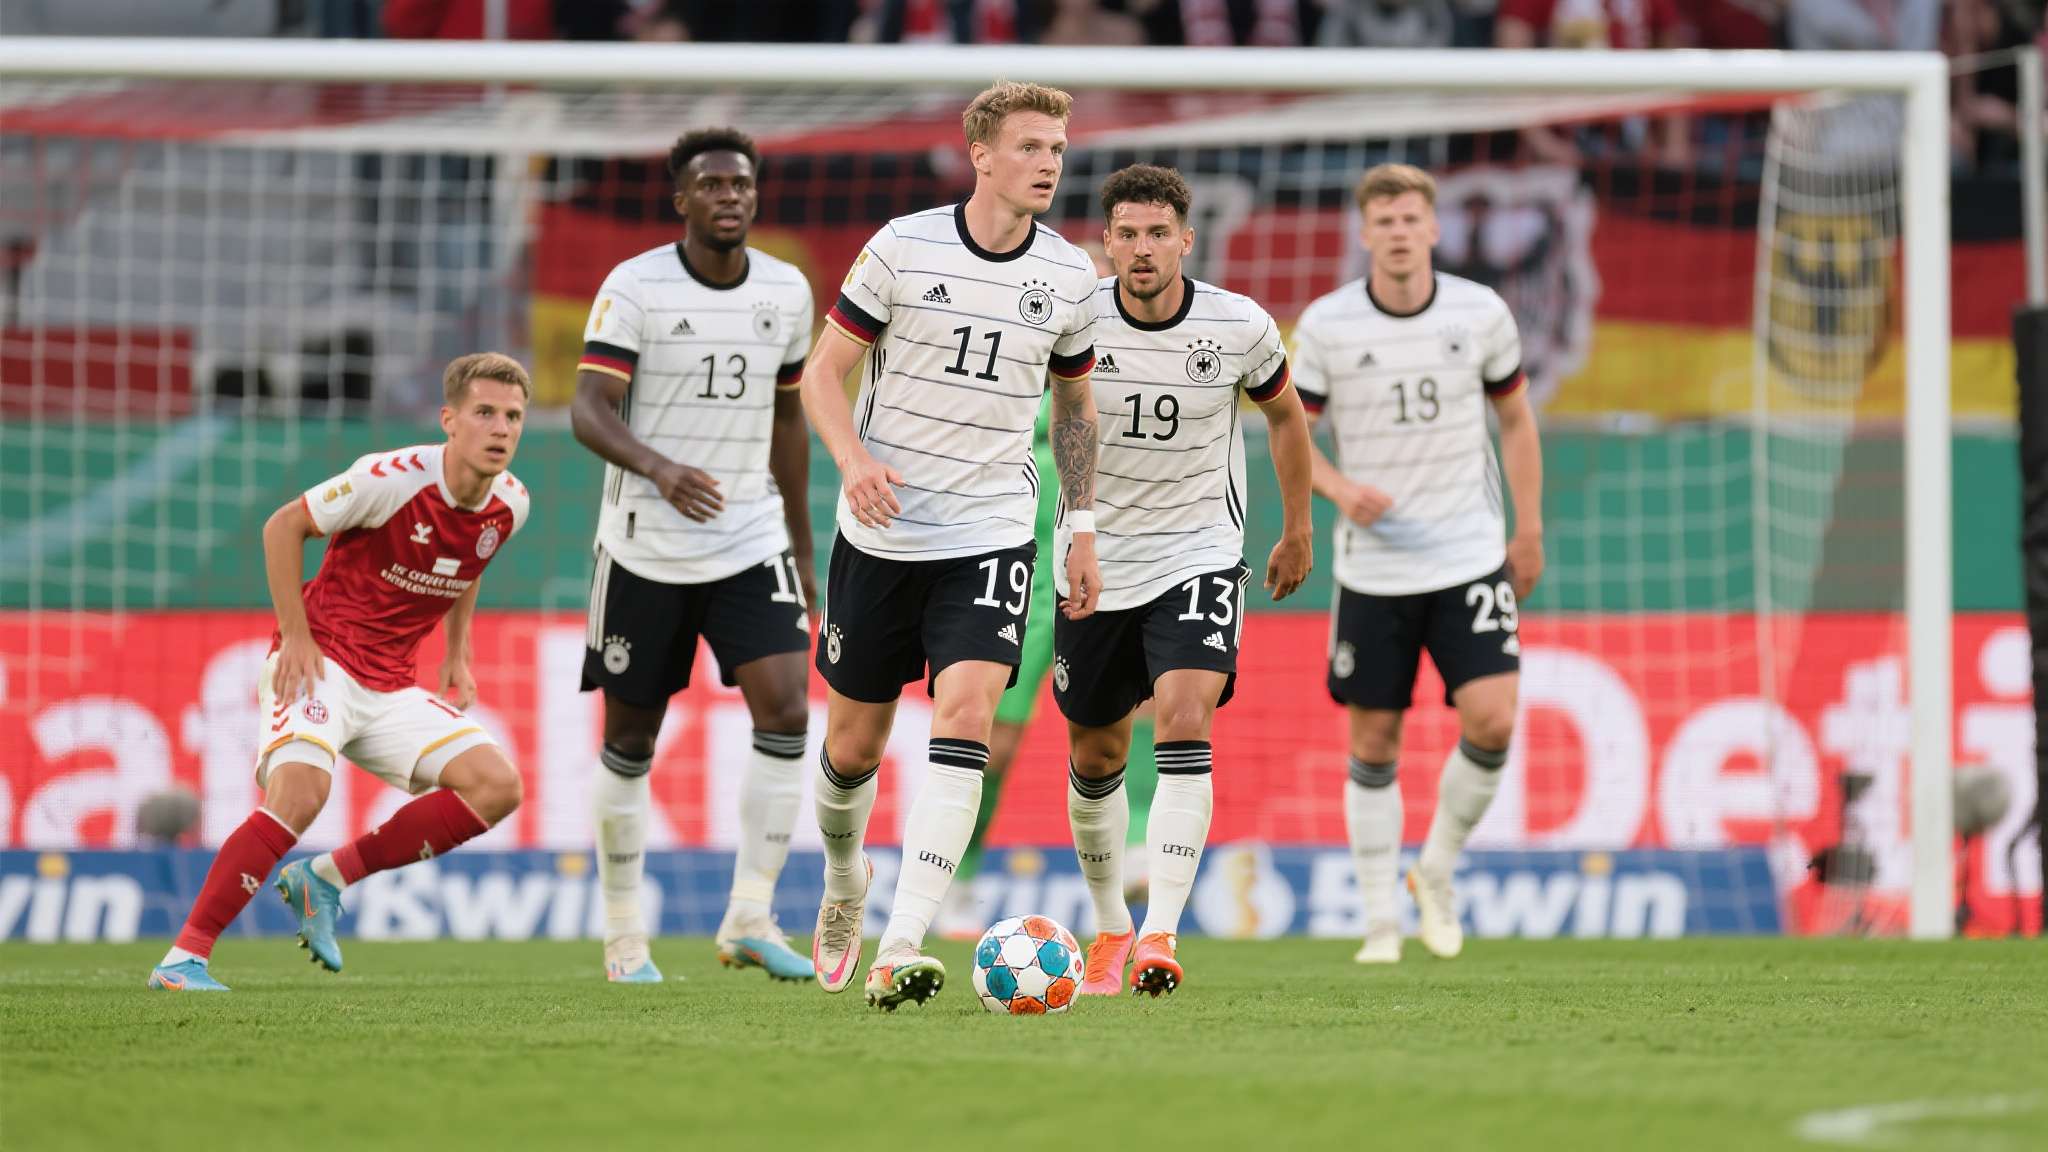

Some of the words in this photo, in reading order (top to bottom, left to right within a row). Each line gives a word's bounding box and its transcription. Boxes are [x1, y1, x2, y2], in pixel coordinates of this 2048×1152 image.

[697, 353, 748, 400] 13
[944, 325, 1002, 382] 11
[1122, 393, 1180, 441] 19
[974, 557, 1029, 616] 19
[1178, 575, 1235, 626] 13
[1465, 581, 1519, 634] 29
